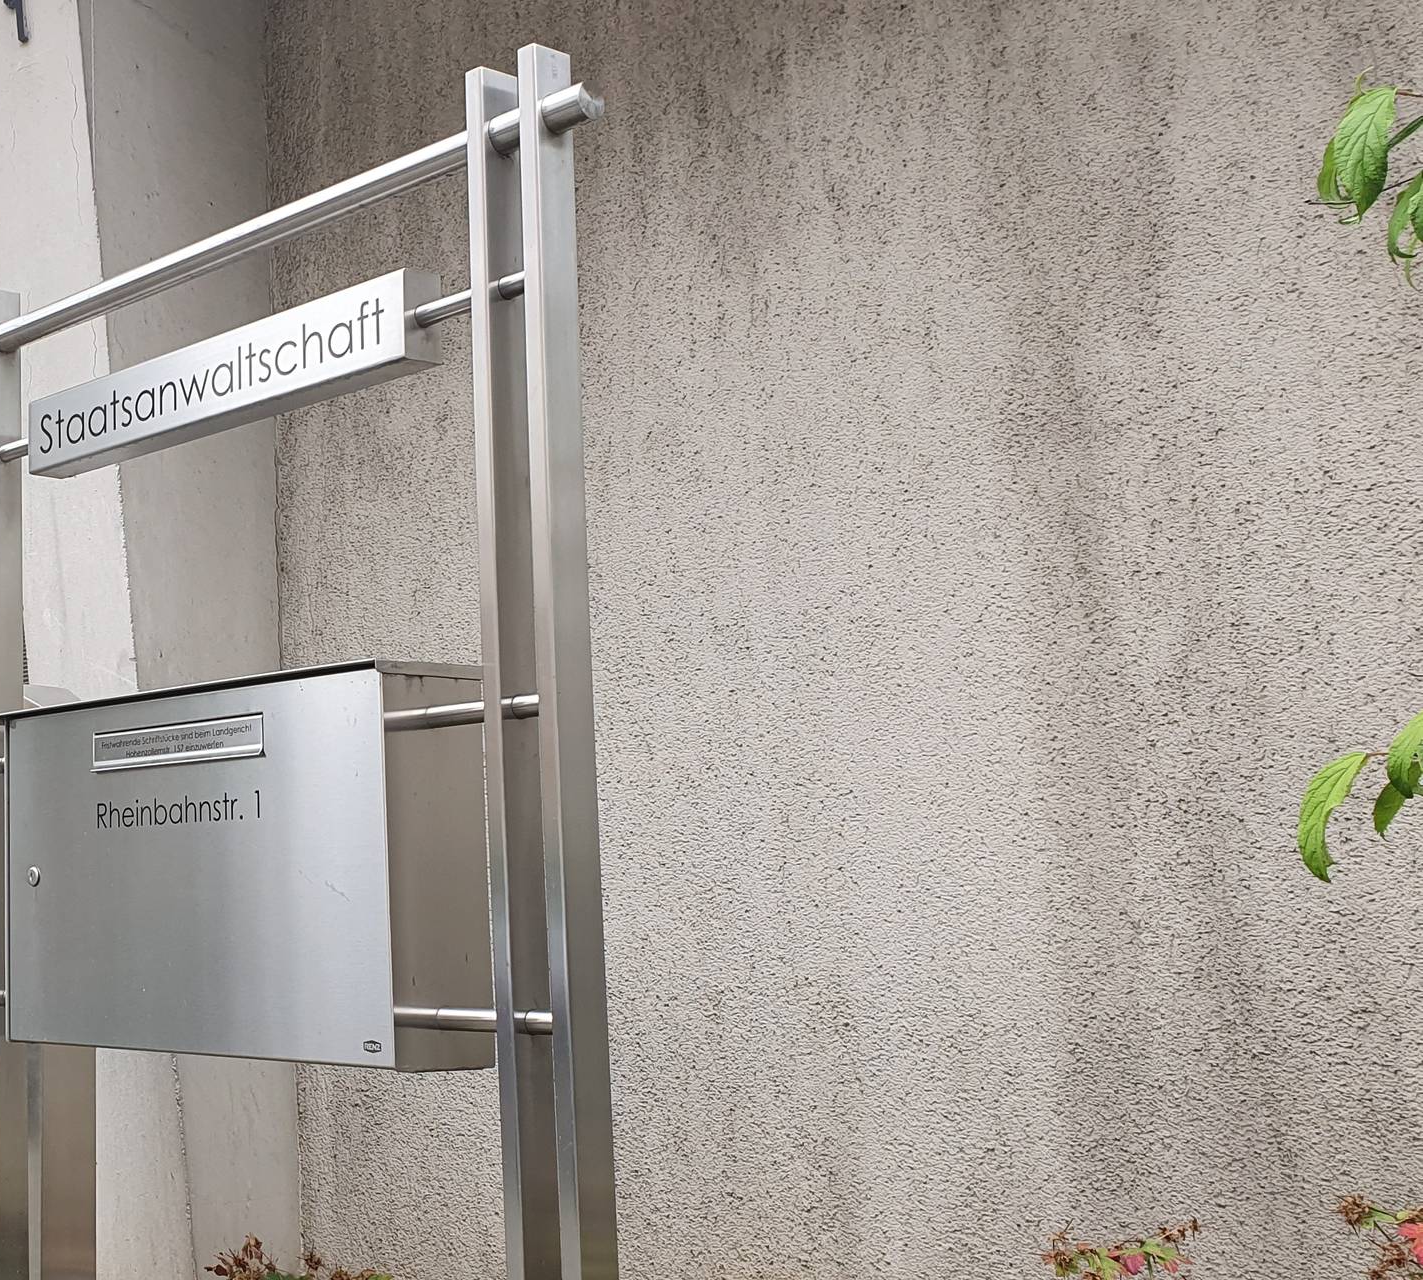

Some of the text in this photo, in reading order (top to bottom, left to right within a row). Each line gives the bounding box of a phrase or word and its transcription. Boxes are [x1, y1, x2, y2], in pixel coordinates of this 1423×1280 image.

[38, 297, 386, 455] Staatsanwaltschaft
[194, 729, 211, 739] beim
[96, 789, 261, 829] Rheinbahnstr. 1
